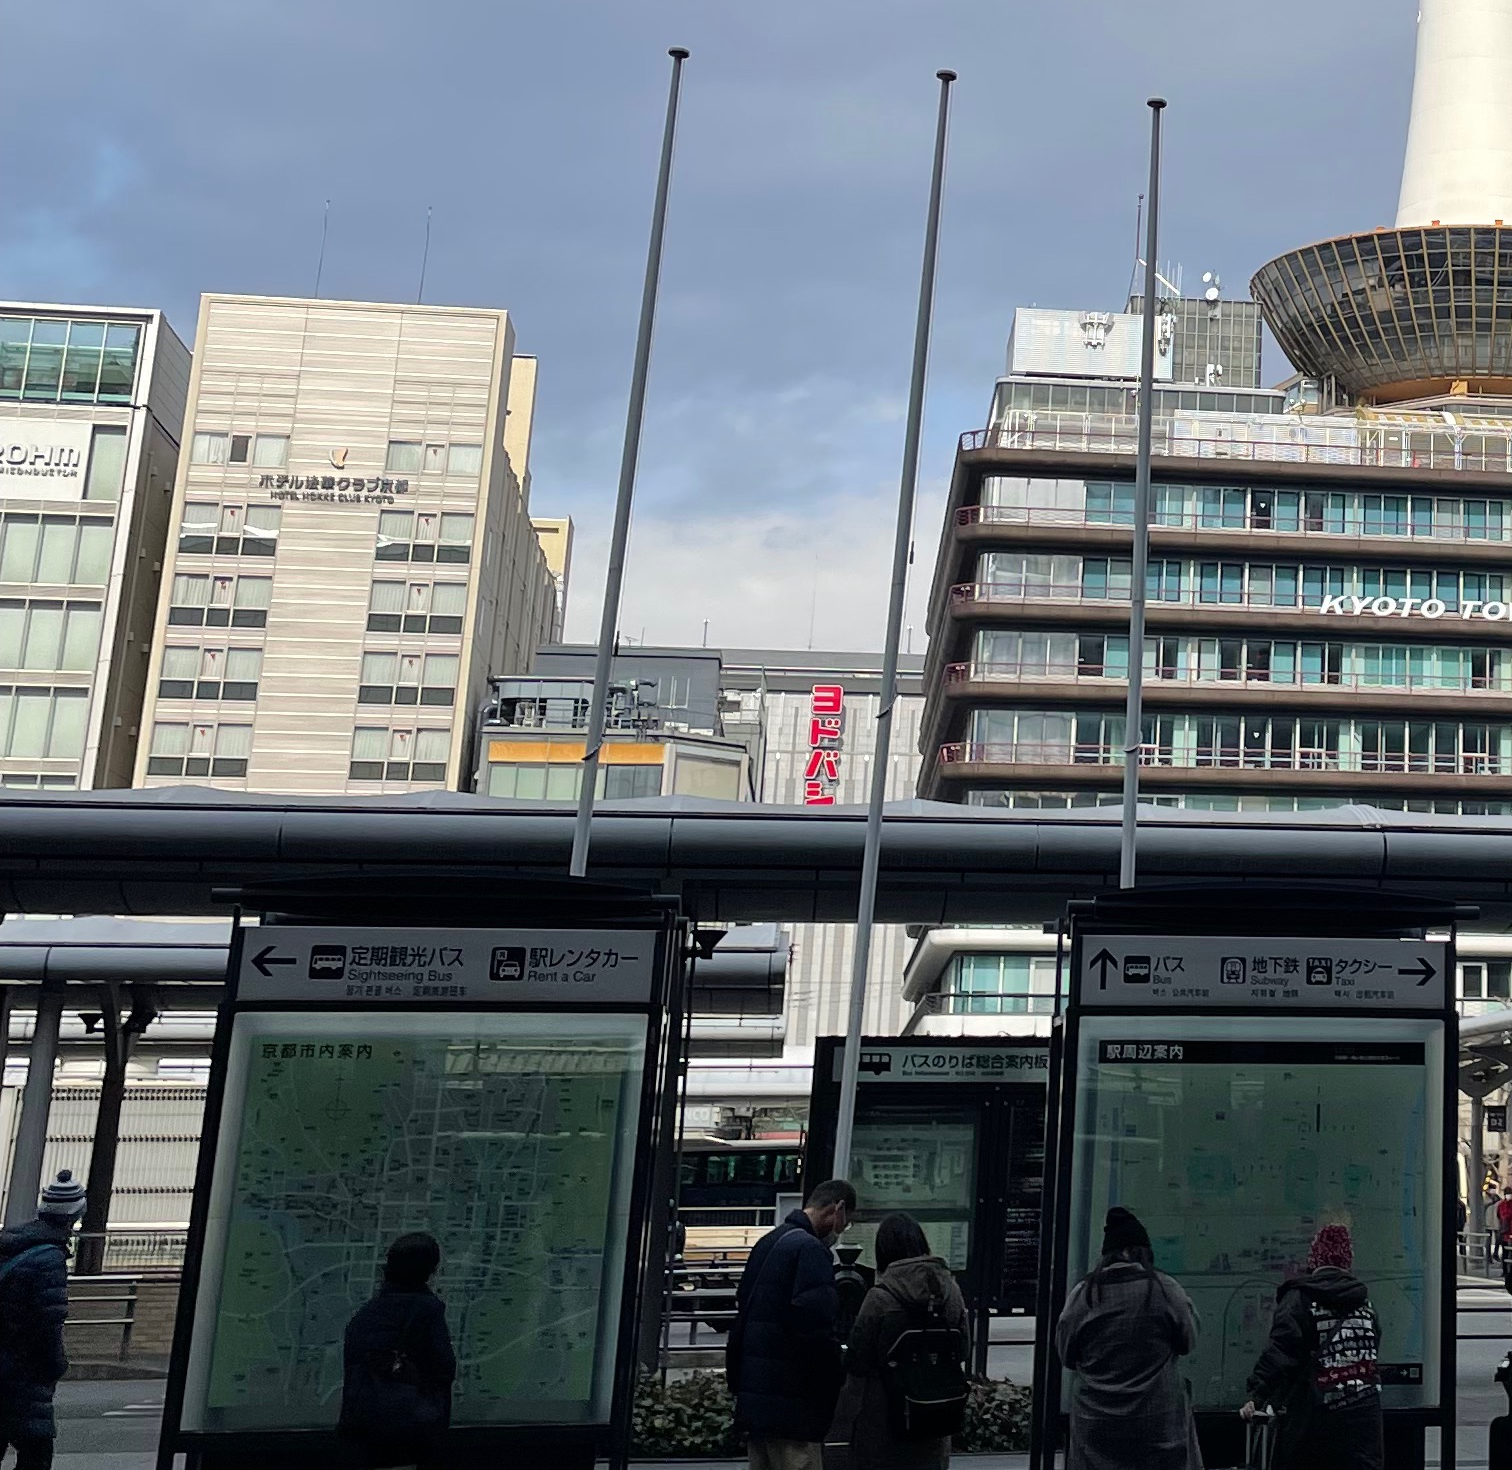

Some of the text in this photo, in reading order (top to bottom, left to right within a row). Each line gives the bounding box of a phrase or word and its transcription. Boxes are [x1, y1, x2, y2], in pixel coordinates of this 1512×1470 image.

[0, 443, 81, 468] OHM
[271, 490, 299, 501] HOTEL
[338, 492, 362, 503] CLUB
[364, 494, 395, 504] KYOTO
[1319, 595, 1447, 619] KYOTO
[804, 684, 843, 805] ヨドバシ
[349, 946, 464, 967] 定期観光バス
[528, 947, 639, 969] 駅レンタカー
[1153, 956, 1185, 972] バス
[1251, 956, 1300, 974] 地下鉄
[1334, 958, 1393, 975] タクシー
[347, 970, 453, 984] Sightseeing Bus
[527, 970, 597, 982] Rent a Car
[1153, 975, 1172, 985] Bus
[1250, 976, 1289, 987] Subway
[1334, 976, 1355, 986] Taxi
[261, 1043, 373, 1060] 京都市内案内
[1105, 1044, 1184, 1060] 駅周辺案内
[902, 1054, 1049, 1070] バスのりば総合案内板
